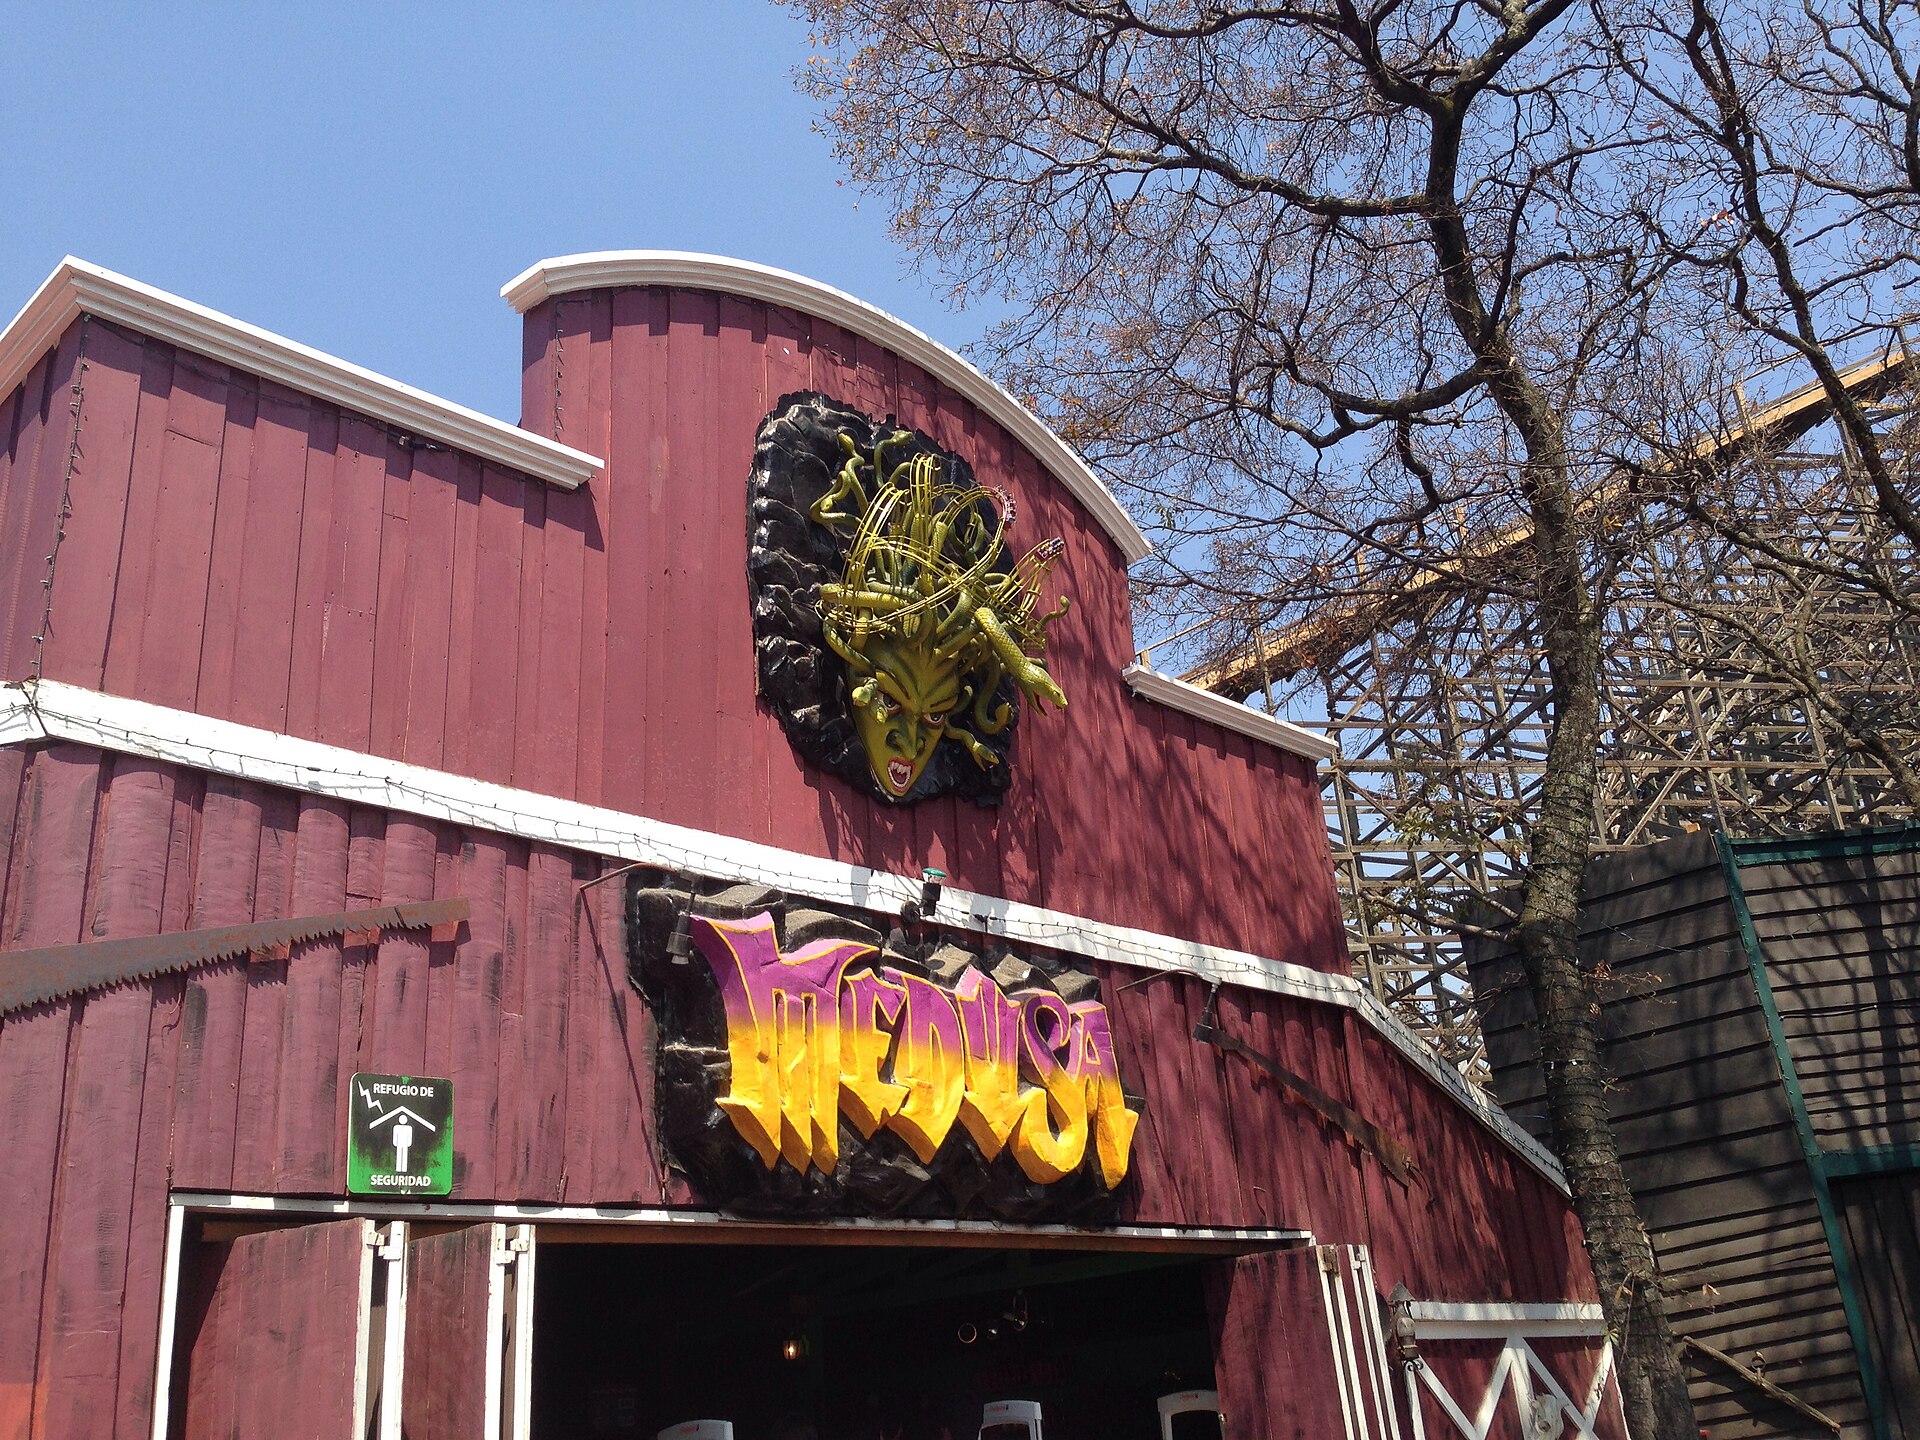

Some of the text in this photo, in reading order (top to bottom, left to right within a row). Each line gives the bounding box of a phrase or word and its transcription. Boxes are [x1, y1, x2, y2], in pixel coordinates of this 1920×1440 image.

[691, 912, 1138, 1190] MEDUSA
[373, 1083, 434, 1097] REFUGIO DE
[370, 1175, 431, 1186] SEGURIDAD
